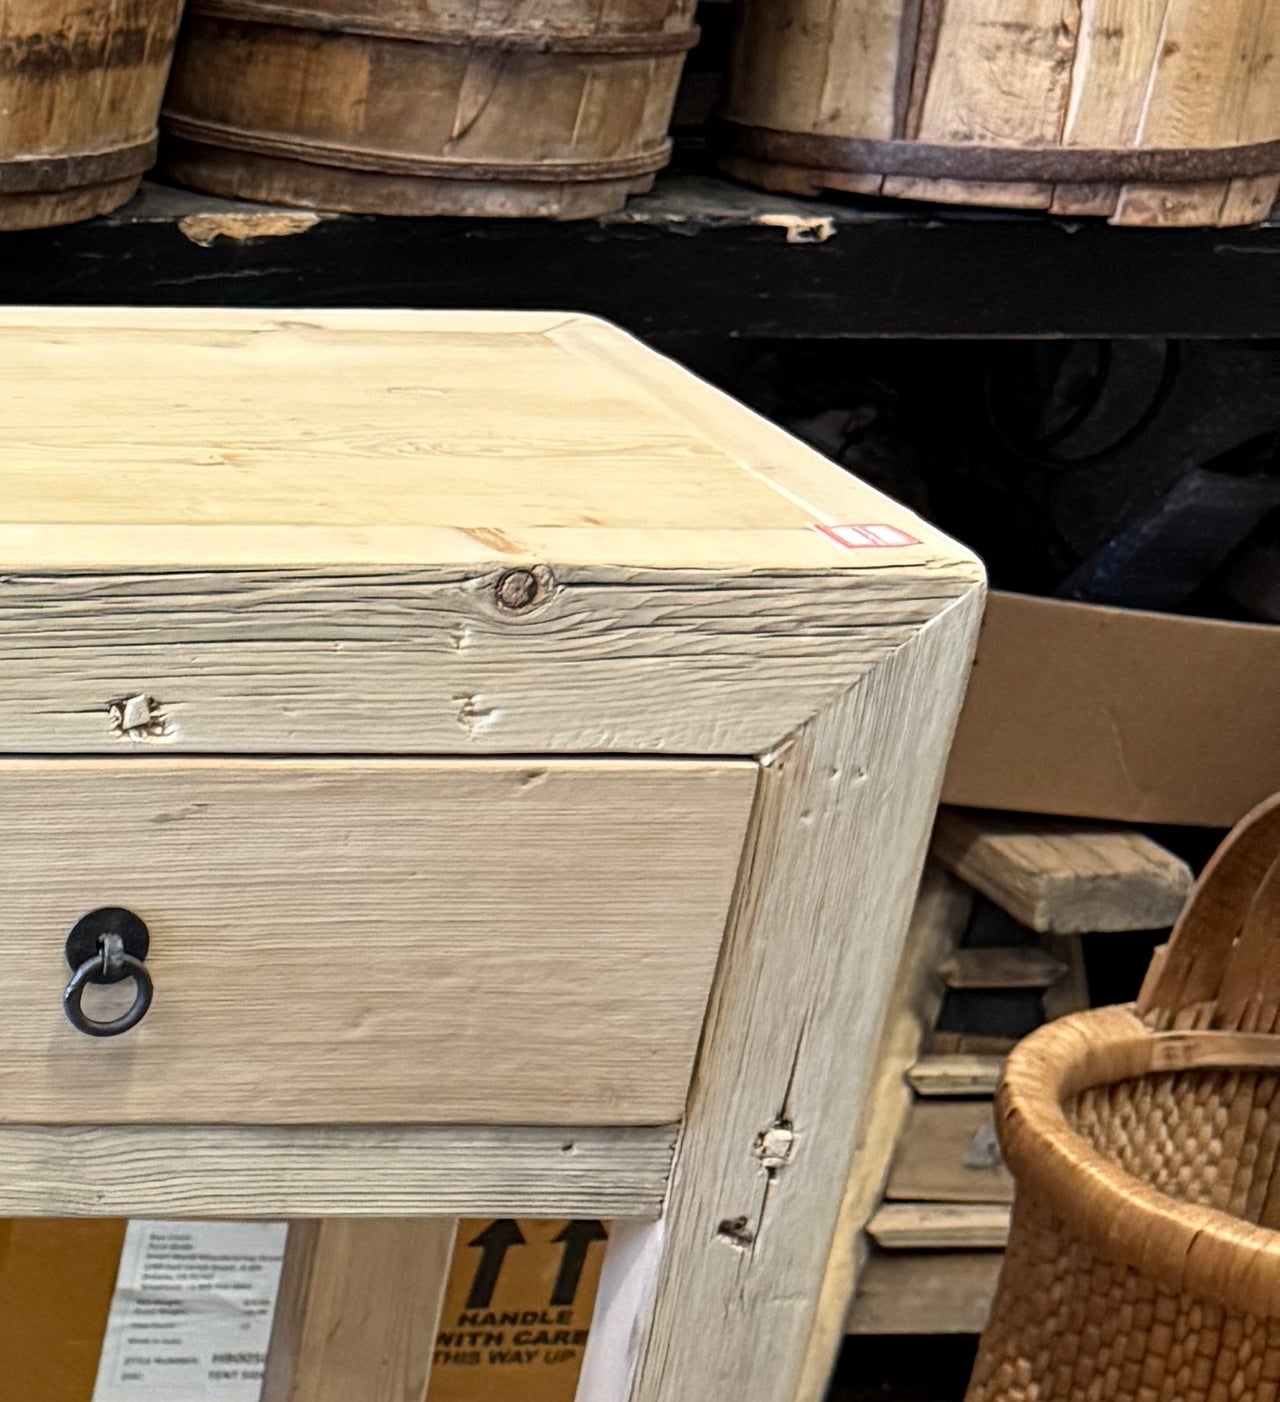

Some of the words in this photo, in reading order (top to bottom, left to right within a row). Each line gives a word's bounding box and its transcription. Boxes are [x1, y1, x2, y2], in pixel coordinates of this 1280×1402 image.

[457, 1309, 574, 1328] HANDLE
[511, 1328, 590, 1346] CARE
[487, 1350, 540, 1365] WAY
[542, 1350, 576, 1365] UP
